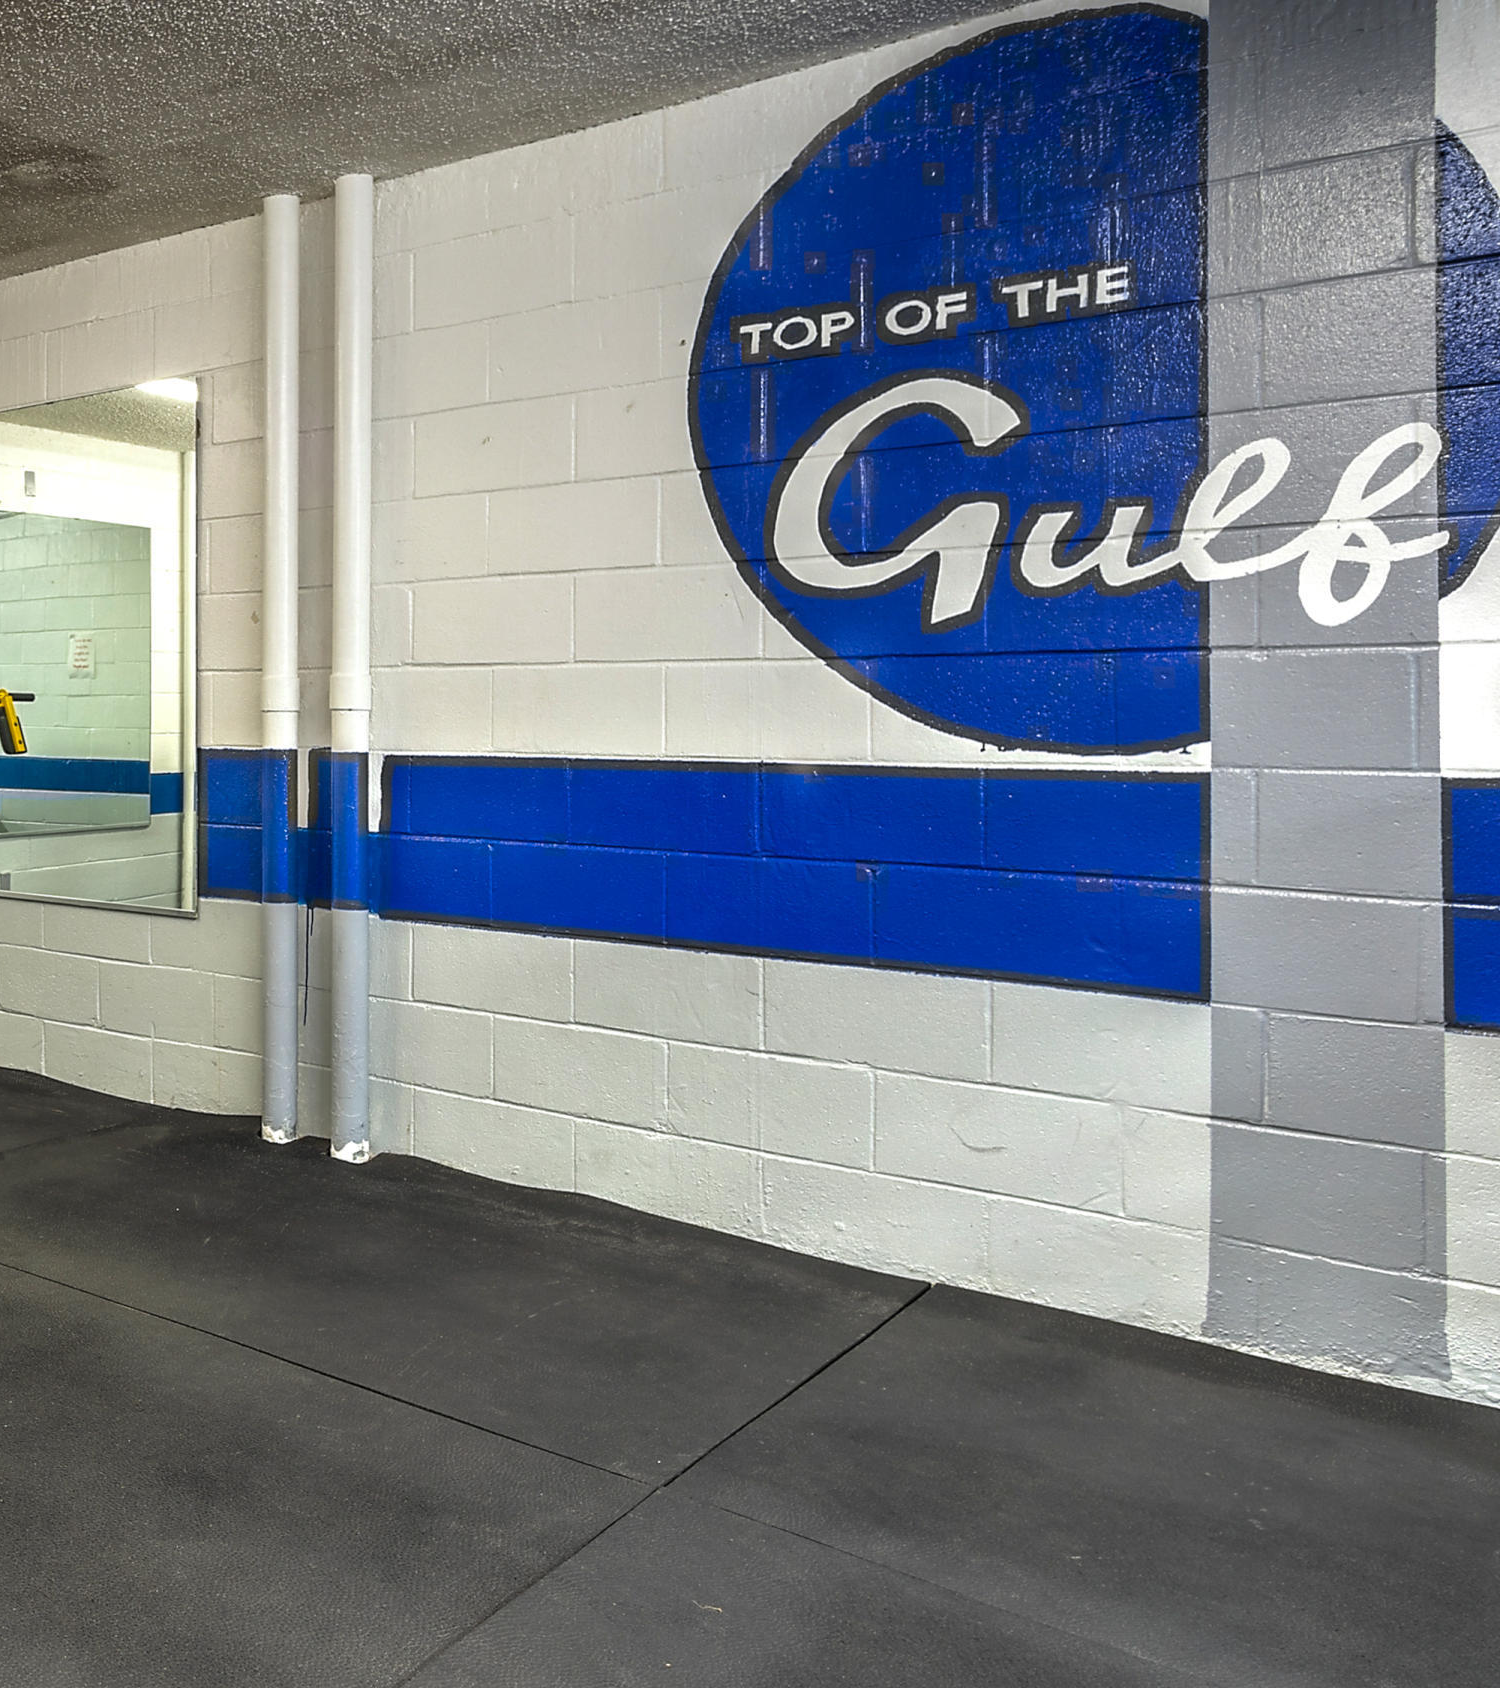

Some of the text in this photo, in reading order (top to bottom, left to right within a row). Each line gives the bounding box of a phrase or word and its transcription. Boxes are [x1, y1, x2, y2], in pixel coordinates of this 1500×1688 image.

[739, 266, 1130, 358] TOP OF THE
[774, 377, 1450, 628] Gulf
